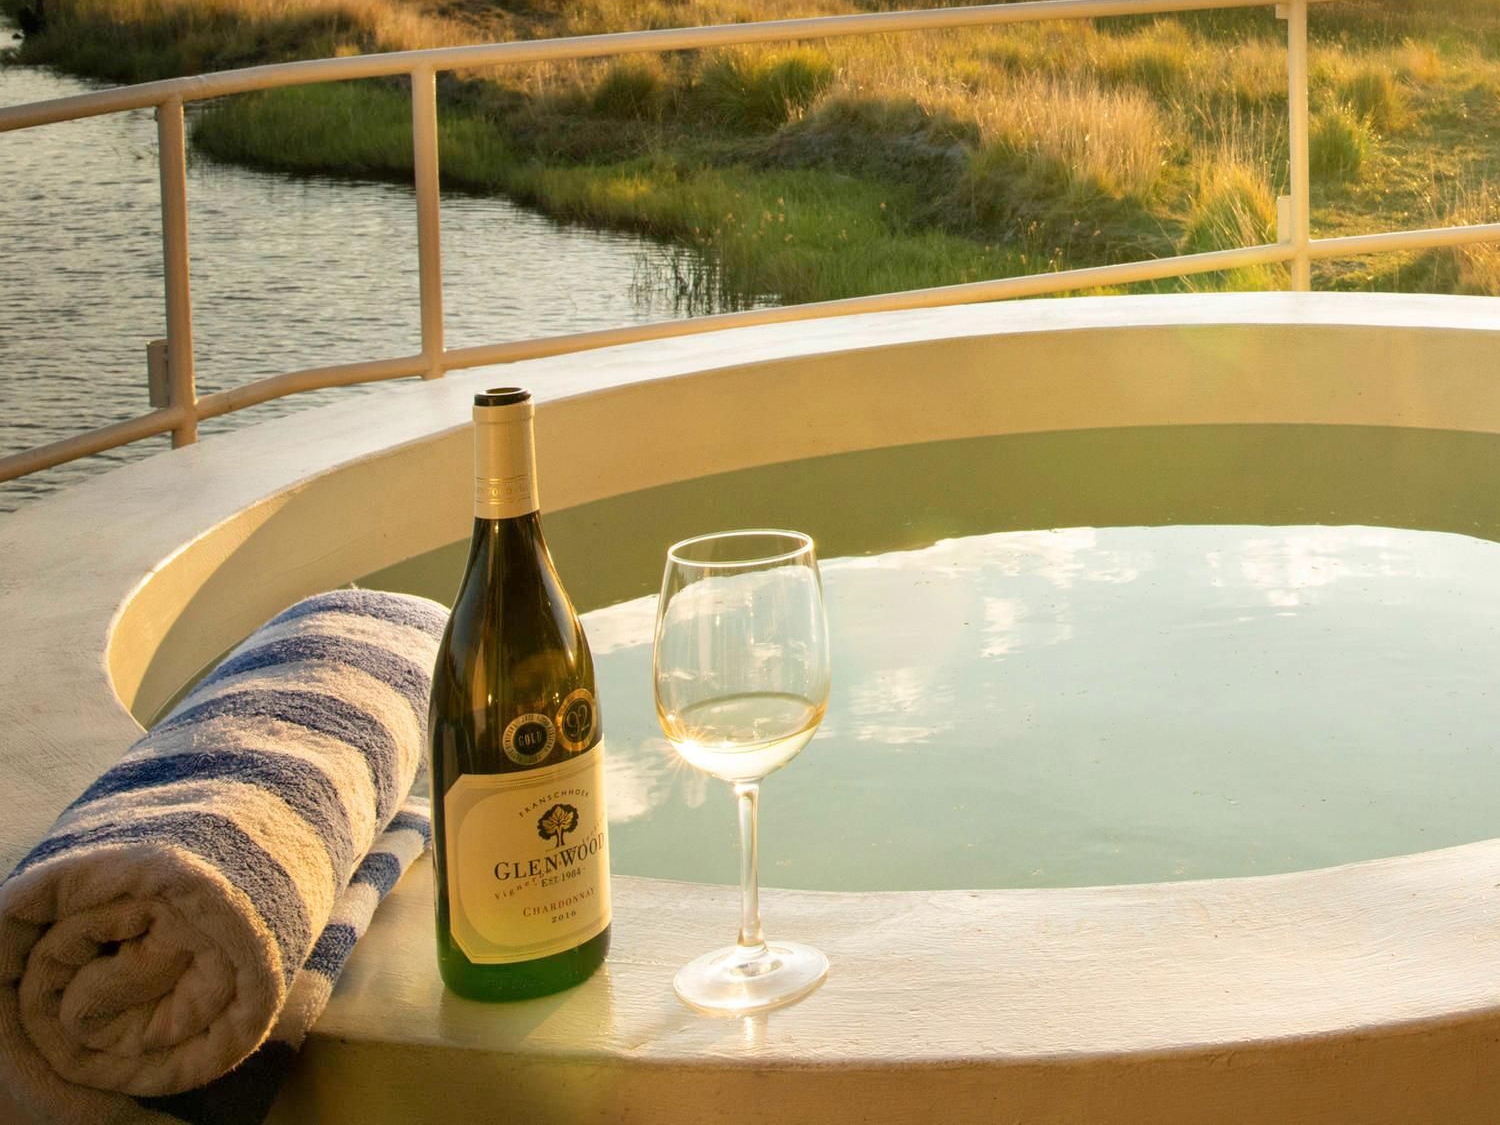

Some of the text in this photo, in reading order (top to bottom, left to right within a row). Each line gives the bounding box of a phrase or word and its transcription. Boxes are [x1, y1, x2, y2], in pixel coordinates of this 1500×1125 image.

[518, 729, 542, 748] GOLD
[494, 832, 605, 881] GLENWOOD
[561, 867, 581, 882] 1984
[523, 887, 595, 917] CHARDONNAY
[551, 910, 577, 924] 2016
